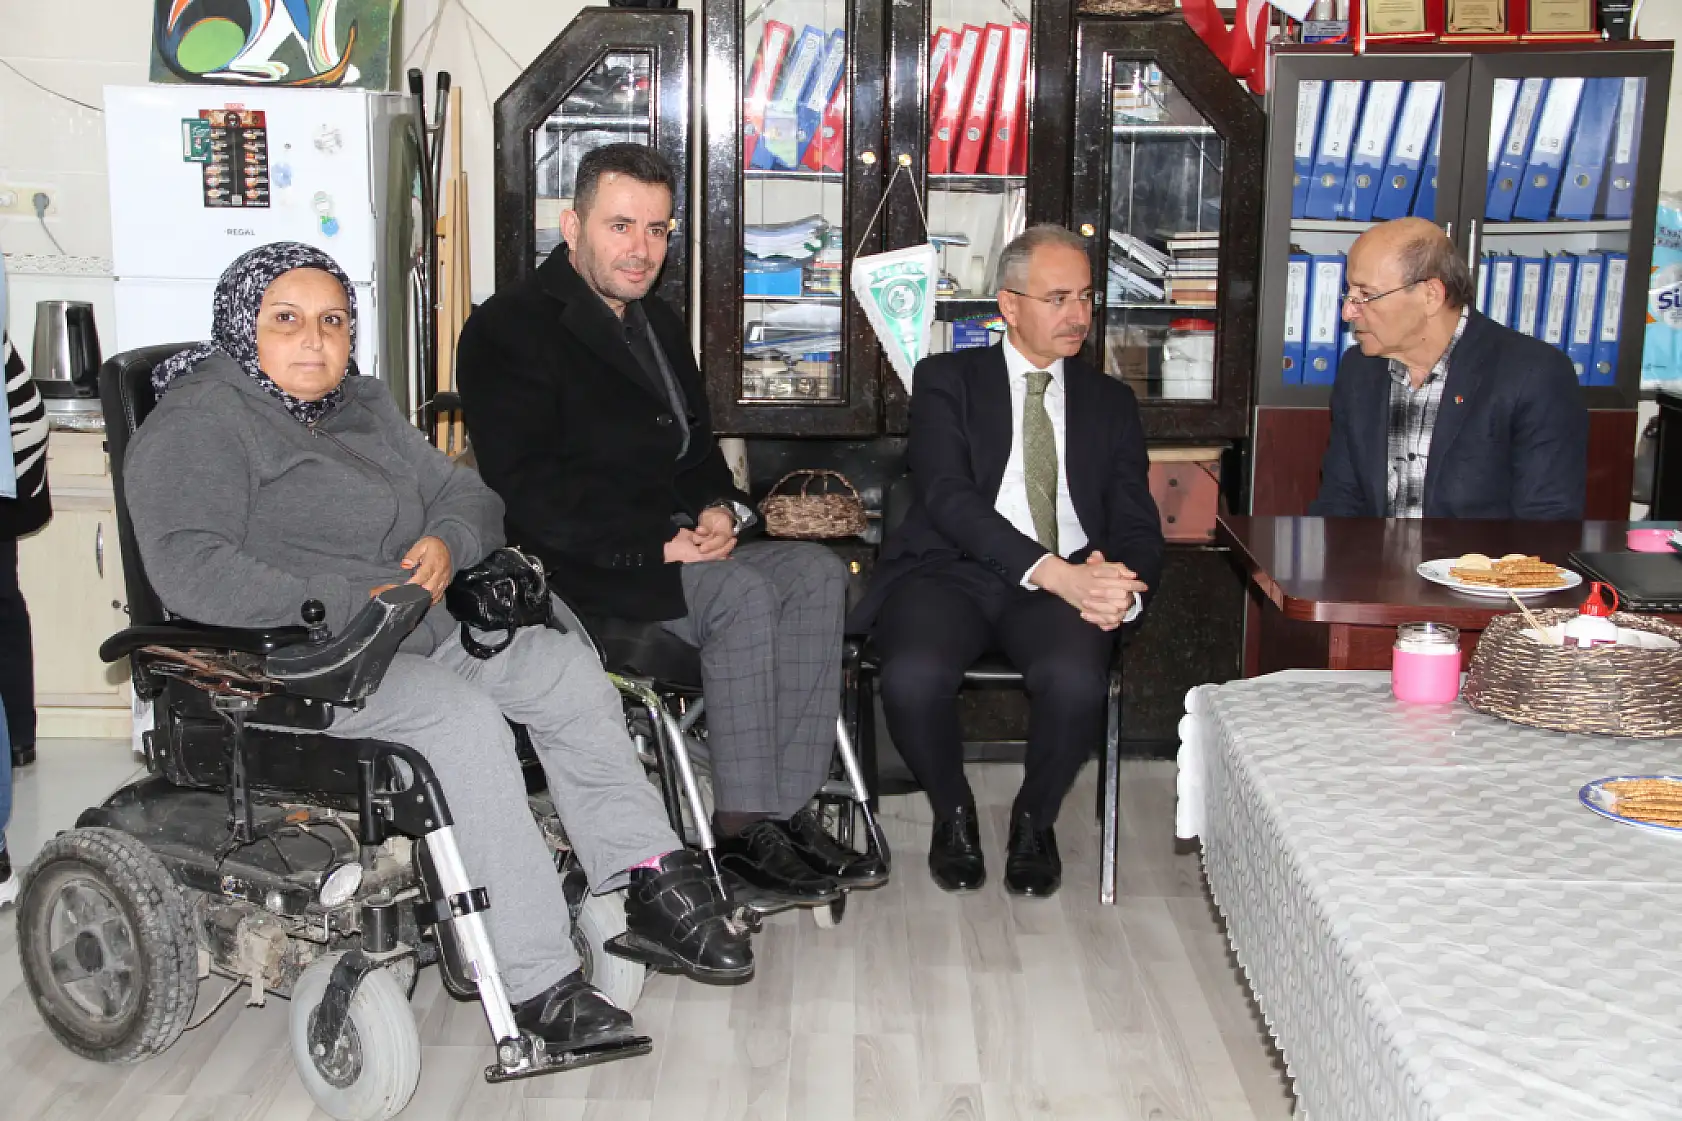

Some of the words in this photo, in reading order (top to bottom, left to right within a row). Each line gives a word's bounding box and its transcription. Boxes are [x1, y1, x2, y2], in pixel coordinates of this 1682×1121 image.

[1331, 141, 1341, 152] 2
[1367, 140, 1376, 151] 3
[226, 228, 256, 236] REGAL
